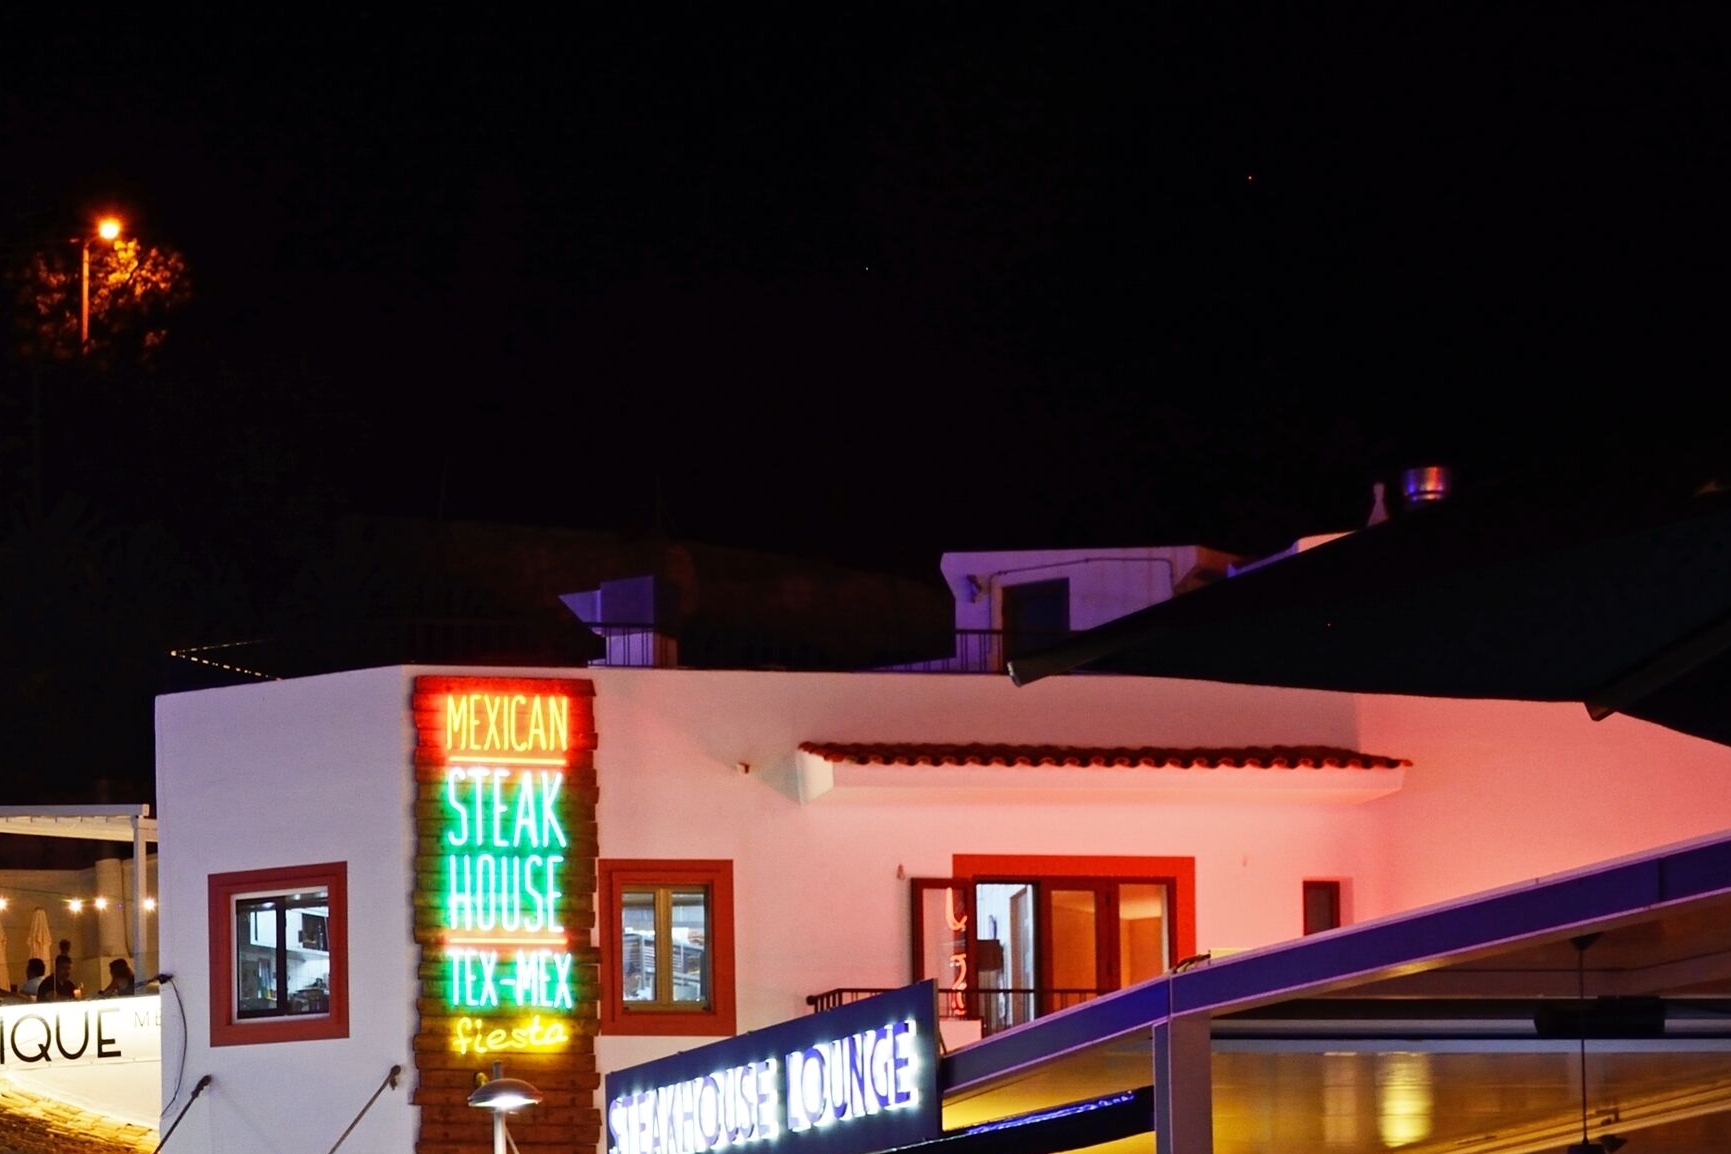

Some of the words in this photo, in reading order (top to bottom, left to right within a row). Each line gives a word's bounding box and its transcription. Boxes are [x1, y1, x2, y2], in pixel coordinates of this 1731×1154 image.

[446, 694, 568, 752] MEXICAN
[447, 766, 567, 848] STEAK
[448, 854, 565, 933] HOUSE
[447, 948, 573, 1009] TEX-MEX
[452, 1014, 569, 1055] fiesta
[784, 1018, 920, 1132] LOUNGE
